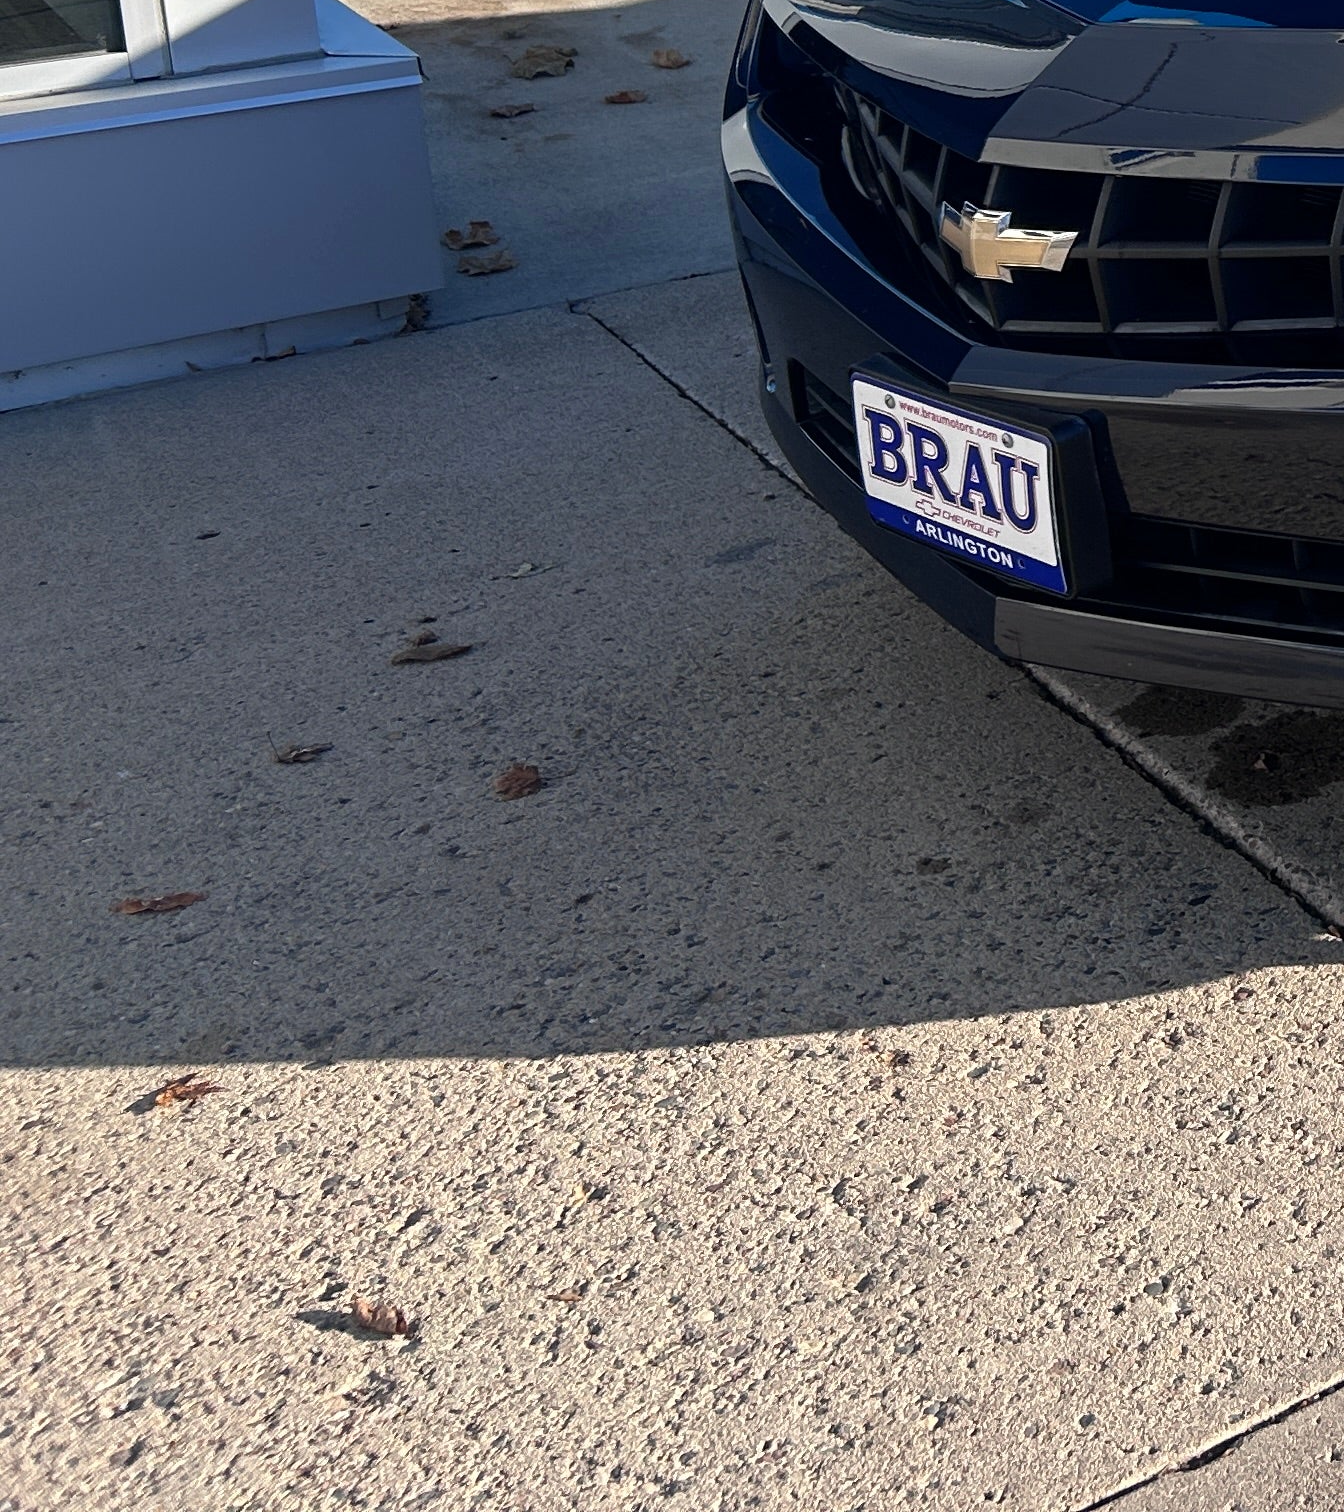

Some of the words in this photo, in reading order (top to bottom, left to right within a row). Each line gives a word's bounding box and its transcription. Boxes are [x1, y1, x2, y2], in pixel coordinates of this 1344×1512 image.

[898, 399, 998, 443] www.braumotors.com
[862, 404, 1041, 535] BRAU
[915, 519, 1014, 569] ARLINGTON
[942, 509, 1001, 539] CHEVROLET
